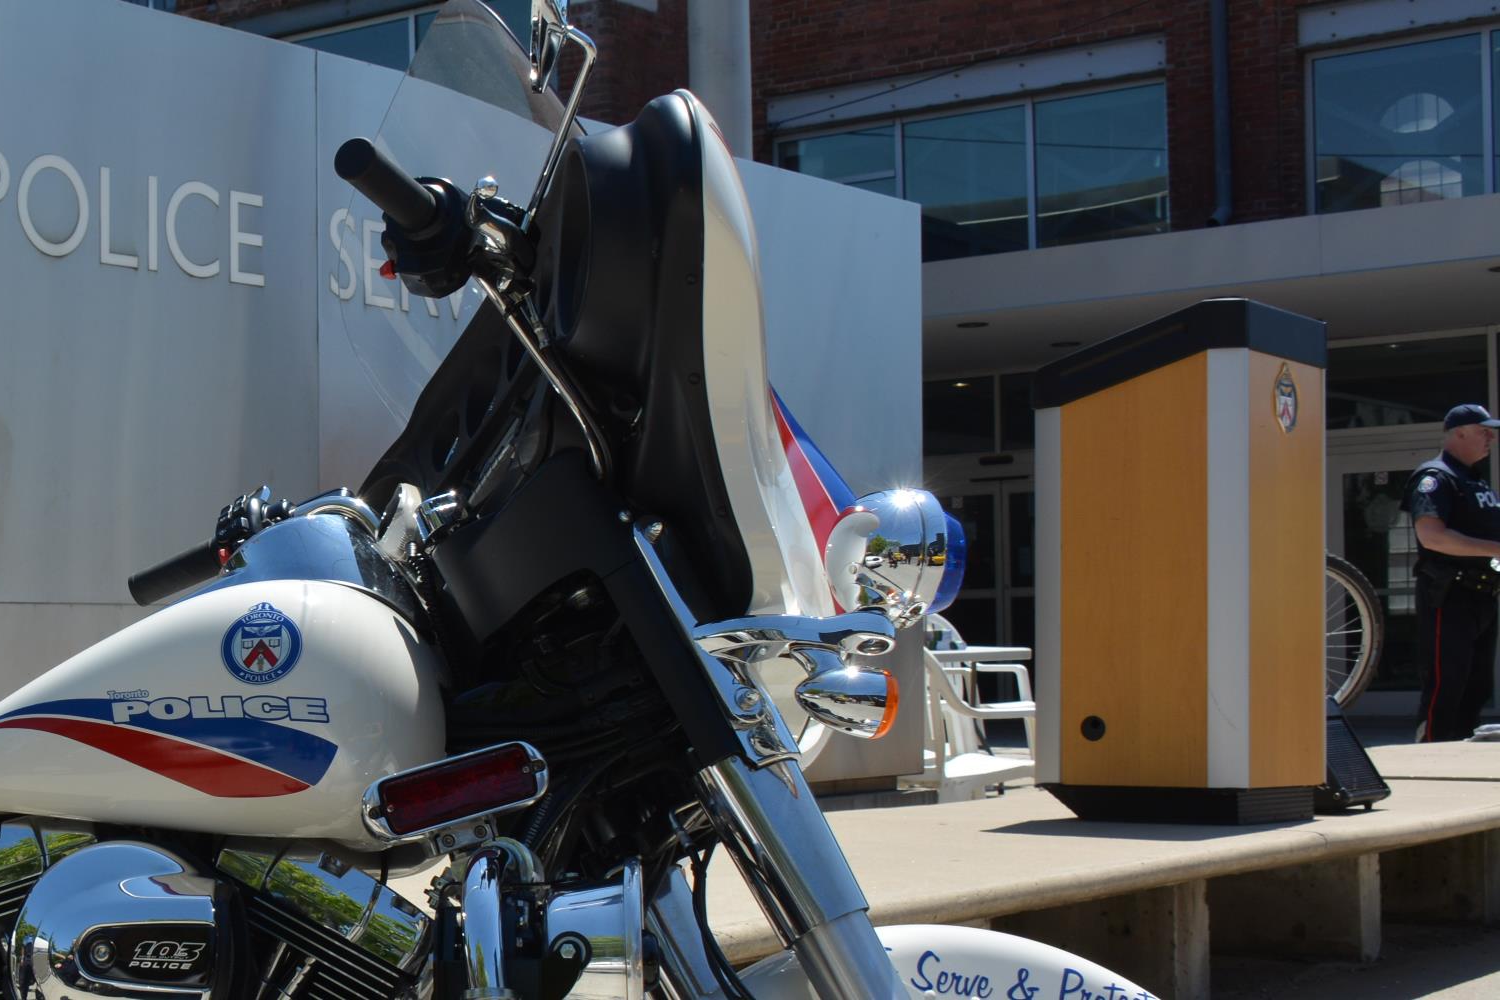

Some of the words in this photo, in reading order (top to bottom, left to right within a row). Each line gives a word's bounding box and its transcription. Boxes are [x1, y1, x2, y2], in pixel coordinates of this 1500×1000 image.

[241, 611, 285, 624] TORONTO
[243, 671, 277, 682] POLICE
[107, 689, 149, 700] Toronto
[111, 695, 330, 724] POLICE
[133, 940, 206, 962] 103
[129, 960, 192, 970] POLICE
[910, 950, 993, 999] Serve
[1007, 968, 1040, 1000] &
